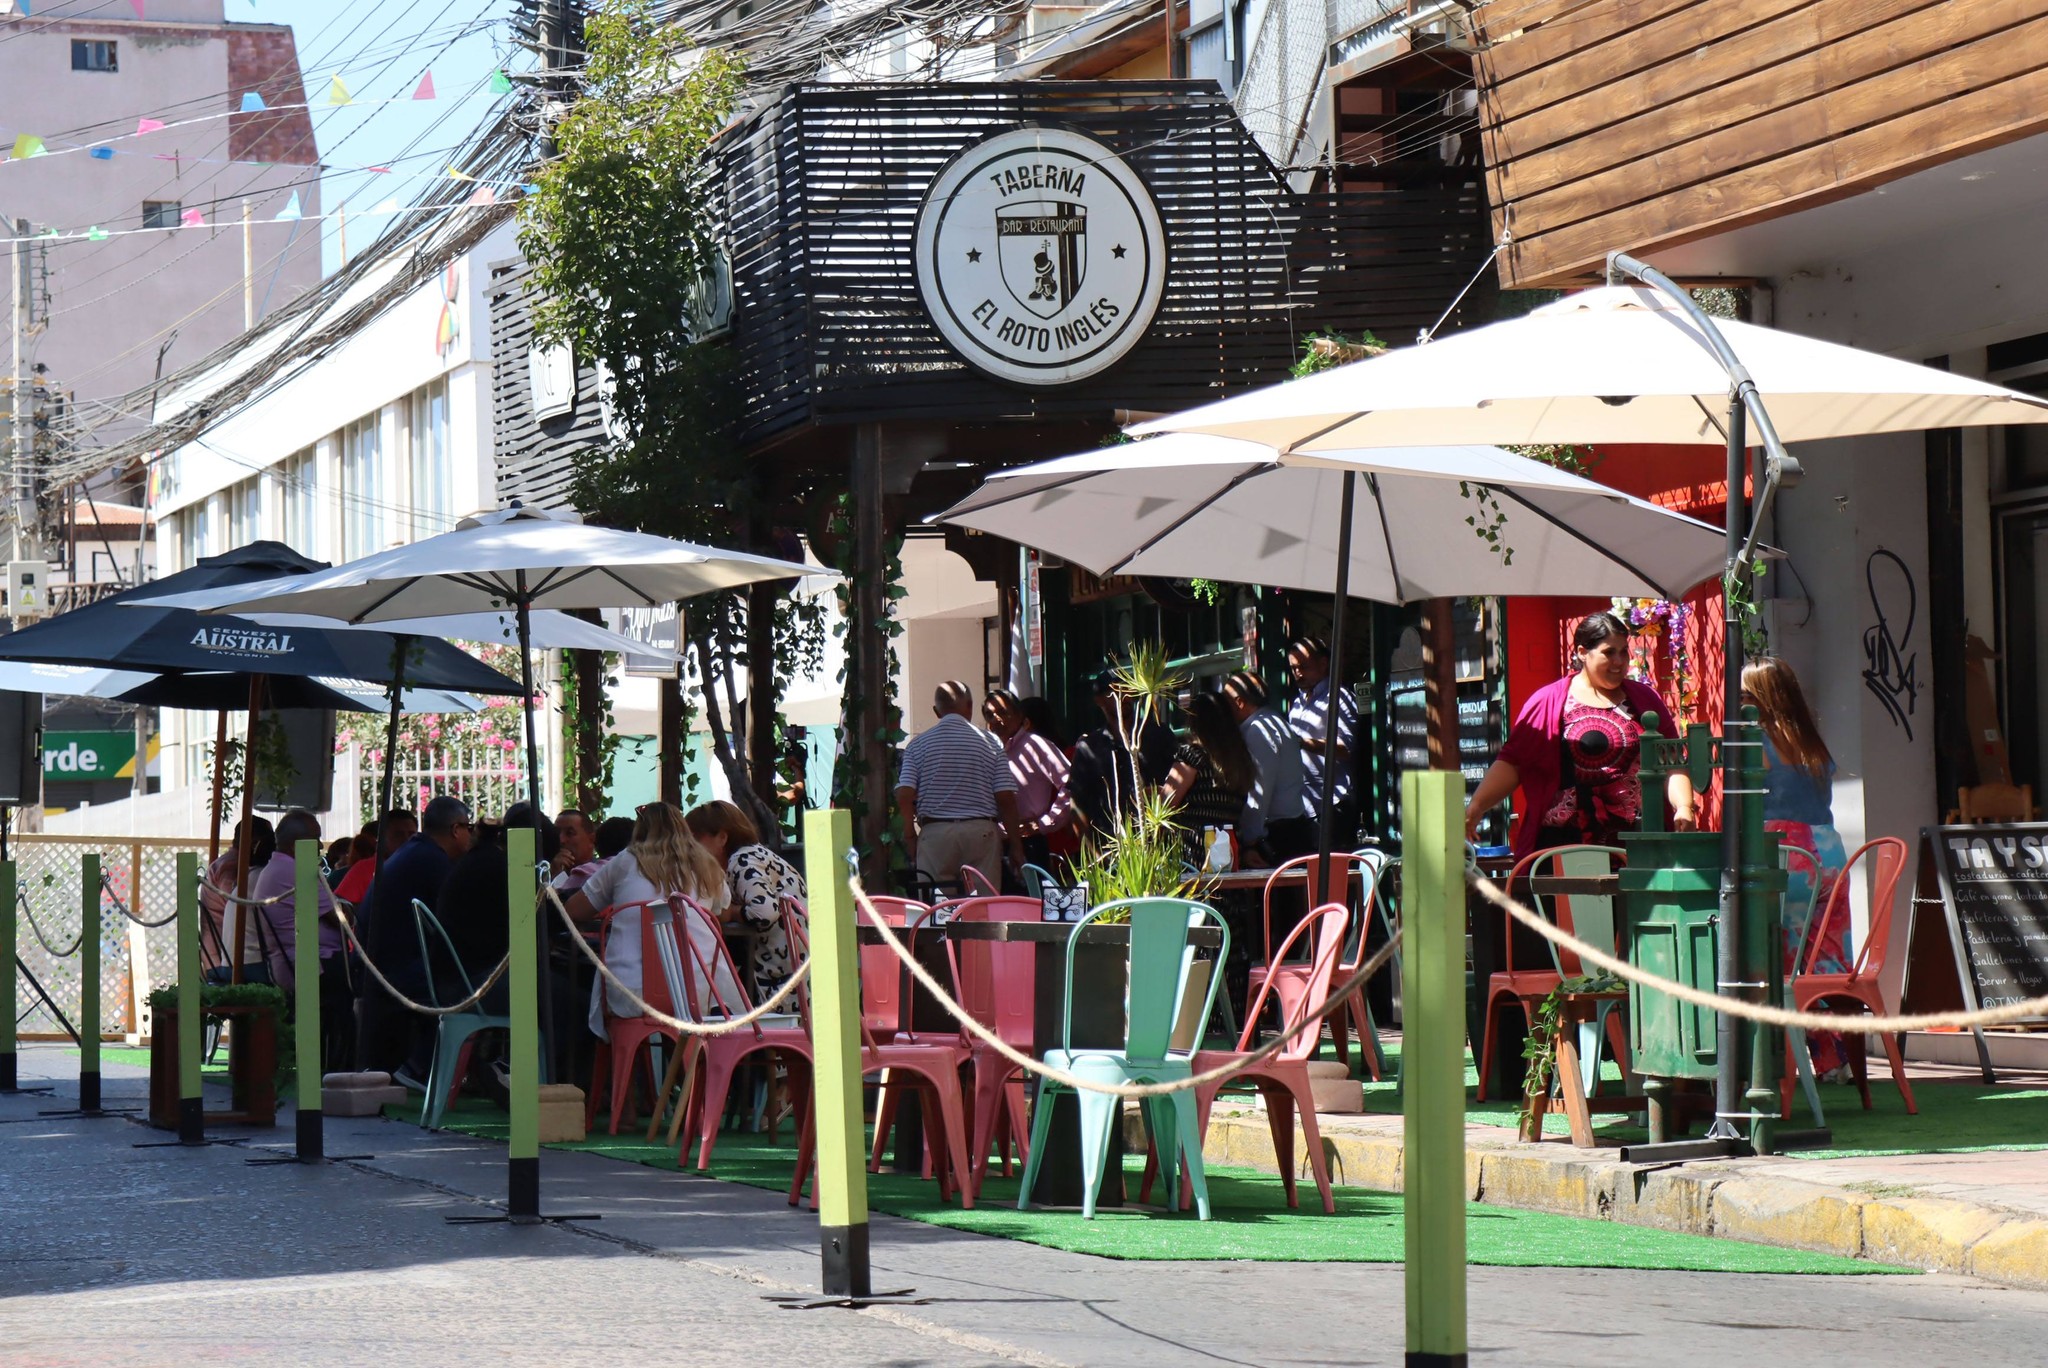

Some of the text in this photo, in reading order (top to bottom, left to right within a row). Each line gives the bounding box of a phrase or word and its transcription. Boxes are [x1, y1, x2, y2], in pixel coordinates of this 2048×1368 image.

[990, 165, 1087, 198] TABERNA
[1003, 218, 1084, 234] BAR RESTAURANT
[971, 297, 1120, 353] EL ROTO INGLÉS
[189, 628, 295, 653] AUSTRAL
[212, 627, 277, 638] CERVEZA
[209, 649, 271, 659] PATAGONIA
[44, 742, 98, 772] rde
[1948, 835, 2048, 869] TAYS
